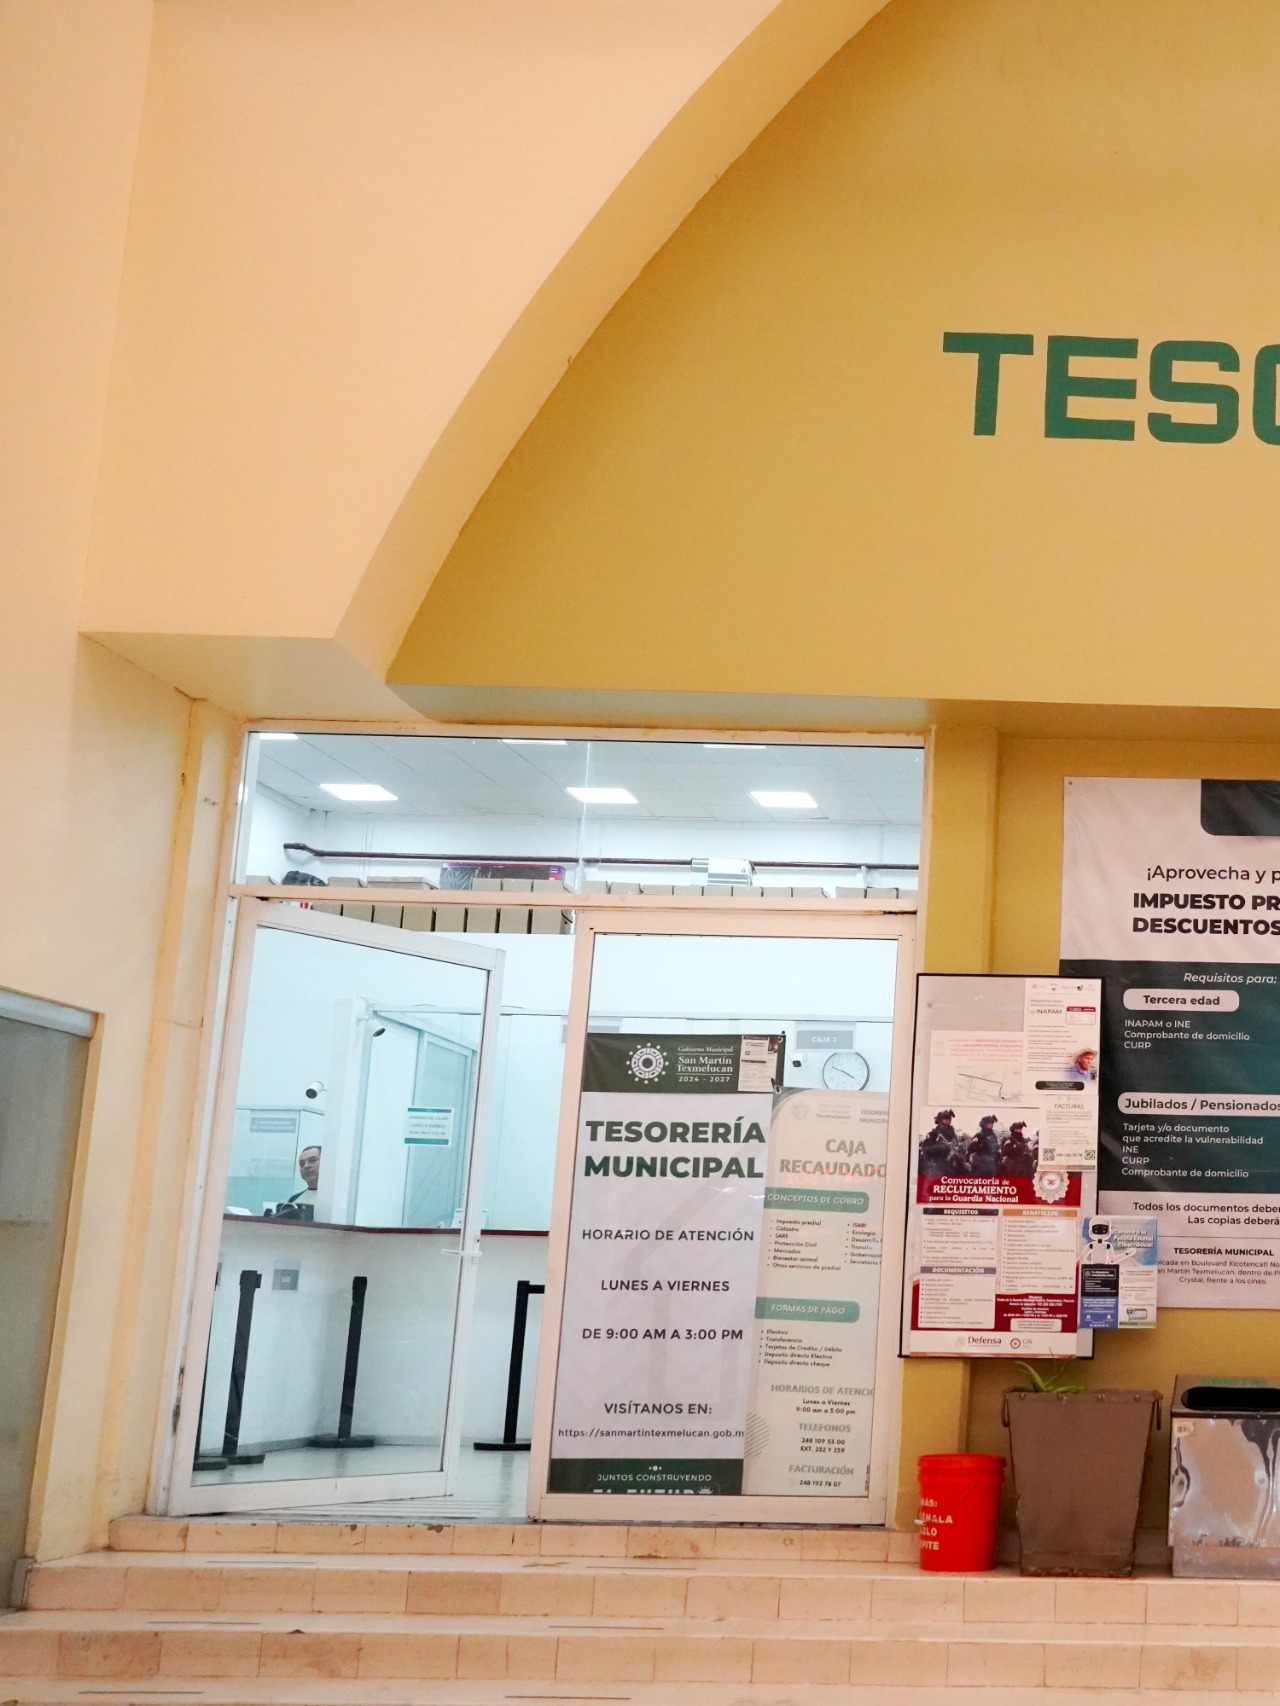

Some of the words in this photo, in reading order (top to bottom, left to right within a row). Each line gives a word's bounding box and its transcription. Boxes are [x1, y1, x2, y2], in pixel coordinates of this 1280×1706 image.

[1147, 865, 1250, 881] ¡Aprovecha
[1255, 870, 1266, 883] y
[1134, 893, 1245, 910] IMPUESTO
[1184, 973, 1243, 984] Requisitos
[1246, 976, 1277, 985] para:
[1143, 995, 1186, 1004] Tercera
[1190, 996, 1220, 1005] edad
[1125, 1020, 1163, 1028] INAPAM
[1124, 1031, 1189, 1039] Comprobante
[1206, 1032, 1249, 1040] domicilio
[1124, 1041, 1151, 1049] CURP
[678, 1056, 696, 1064] San
[677, 1065, 733, 1073] Texmelucan
[1125, 1098, 1188, 1110] Jubilados
[1191, 1099, 1196, 1110] /
[586, 1116, 766, 1144] TESORERÍA
[1123, 1123, 1155, 1132] Tarjeta
[1158, 1124, 1171, 1133] y/o
[1174, 1124, 1229, 1133] documento
[825, 1139, 866, 1157] CAJA
[584, 1156, 764, 1178] MUNICIPAL
[1122, 1168, 1187, 1177] Comprobante
[1190, 1169, 1202, 1177] de
[1205, 1170, 1249, 1178] domicilio
[941, 1176, 999, 1184] Convocatoria
[933, 1185, 1017, 1194] RECLUTAMIENTO
[767, 1194, 818, 1203] CONCEPTOS
[834, 1197, 864, 1205] COBRO
[1133, 1202, 1163, 1211] Todos
[1166, 1203, 1180, 1211] los
[1184, 1203, 1249, 1213] documentos
[1188, 1216, 1205, 1224] Las
[1208, 1216, 1241, 1226] copias
[582, 1229, 650, 1240] HORARIO
[655, 1230, 674, 1240] DE
[678, 1228, 754, 1241] ATENCIÓN
[1174, 1247, 1222, 1255] TESORERÍA
[1225, 1248, 1274, 1256] MUNICIPAL
[601, 1280, 648, 1291] LUNES
[653, 1281, 662, 1290] A
[667, 1281, 730, 1291] VIERNES
[772, 1304, 806, 1312] FORMAS
[582, 1329, 601, 1339] DE
[606, 1329, 638, 1339] 9:00
[643, 1329, 666, 1339] AM
[671, 1329, 680, 1339] A
[685, 1329, 716, 1340] 3:00
[722, 1329, 743, 1340] PM
[968, 1336, 1001, 1345] Defensa
[604, 1400, 683, 1414] VISÍTANOS
[687, 1404, 712, 1414] EN:
[789, 1464, 854, 1475] FACTURACIÓN
